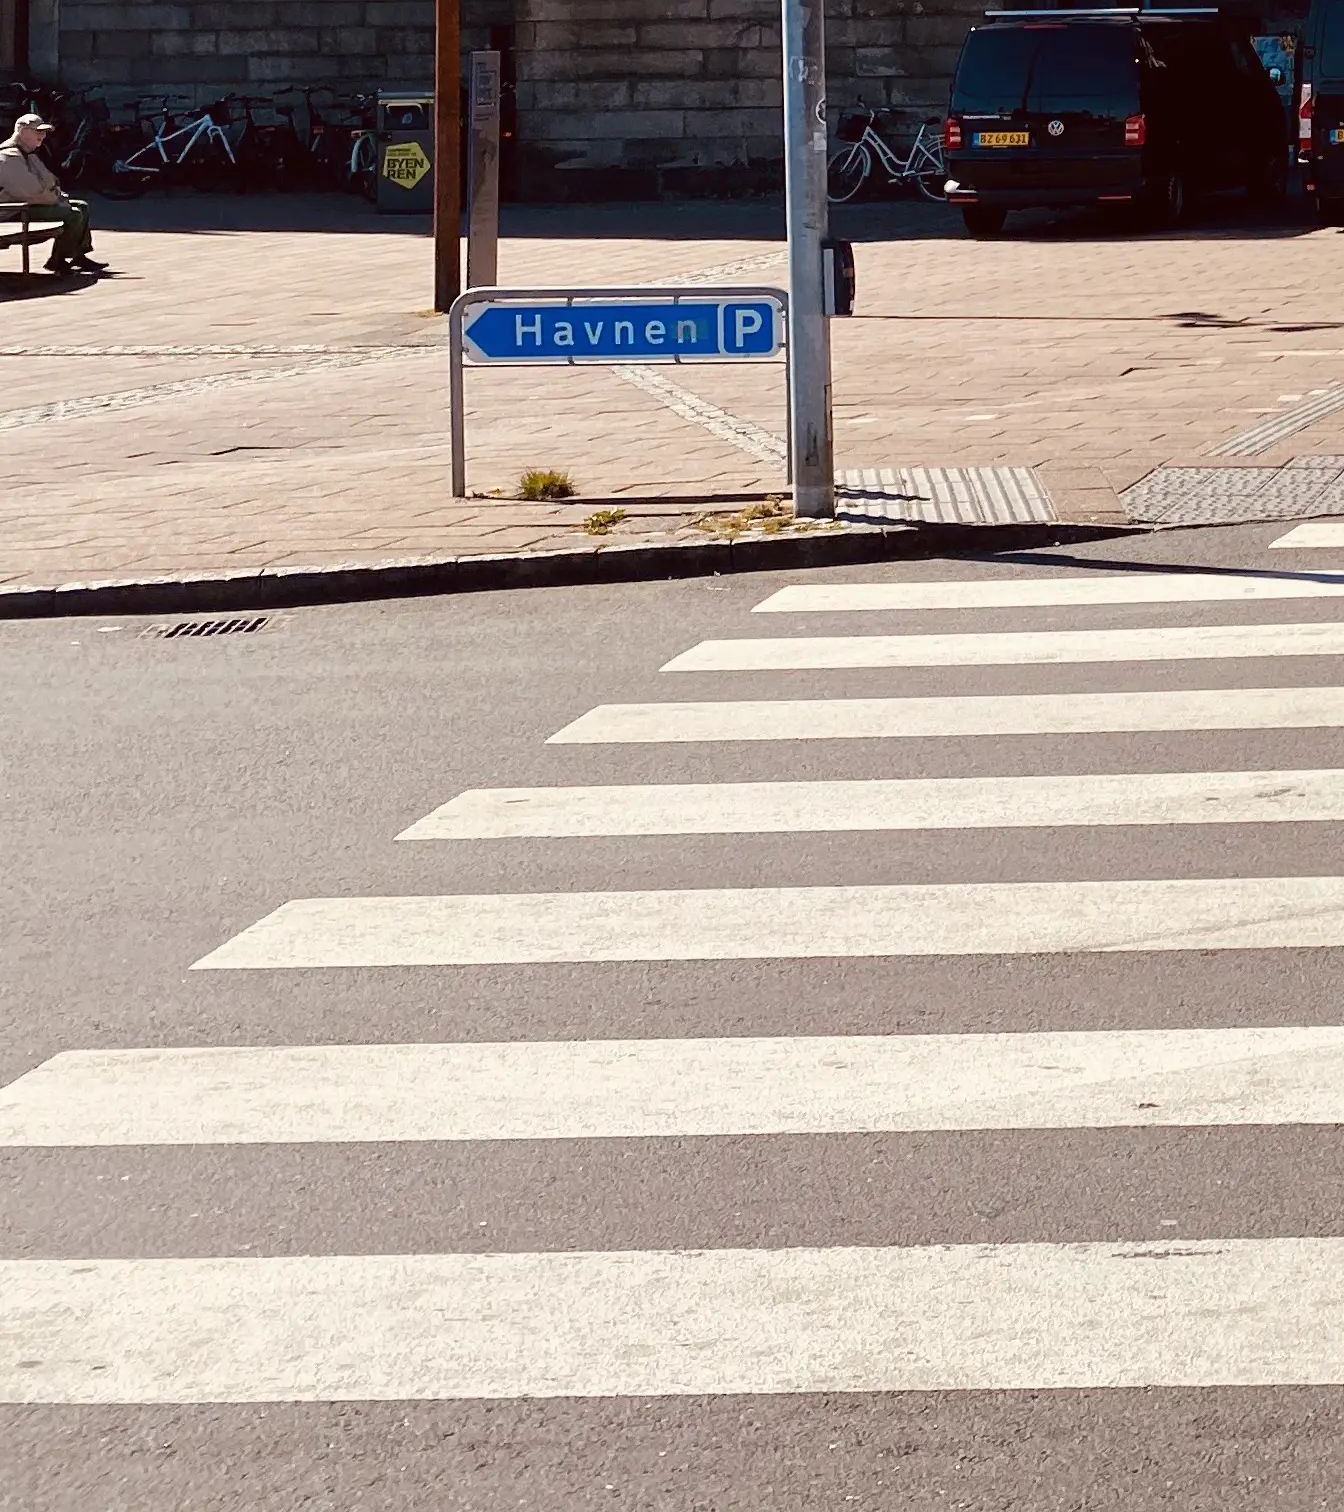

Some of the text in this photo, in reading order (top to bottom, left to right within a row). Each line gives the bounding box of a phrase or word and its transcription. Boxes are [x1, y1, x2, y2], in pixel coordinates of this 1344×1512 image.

[980, 134, 994, 144] BZ
[995, 133, 1007, 144] 69
[387, 158, 424, 168] BYEN
[387, 169, 416, 179] REN
[515, 308, 763, 348] Havnen P
